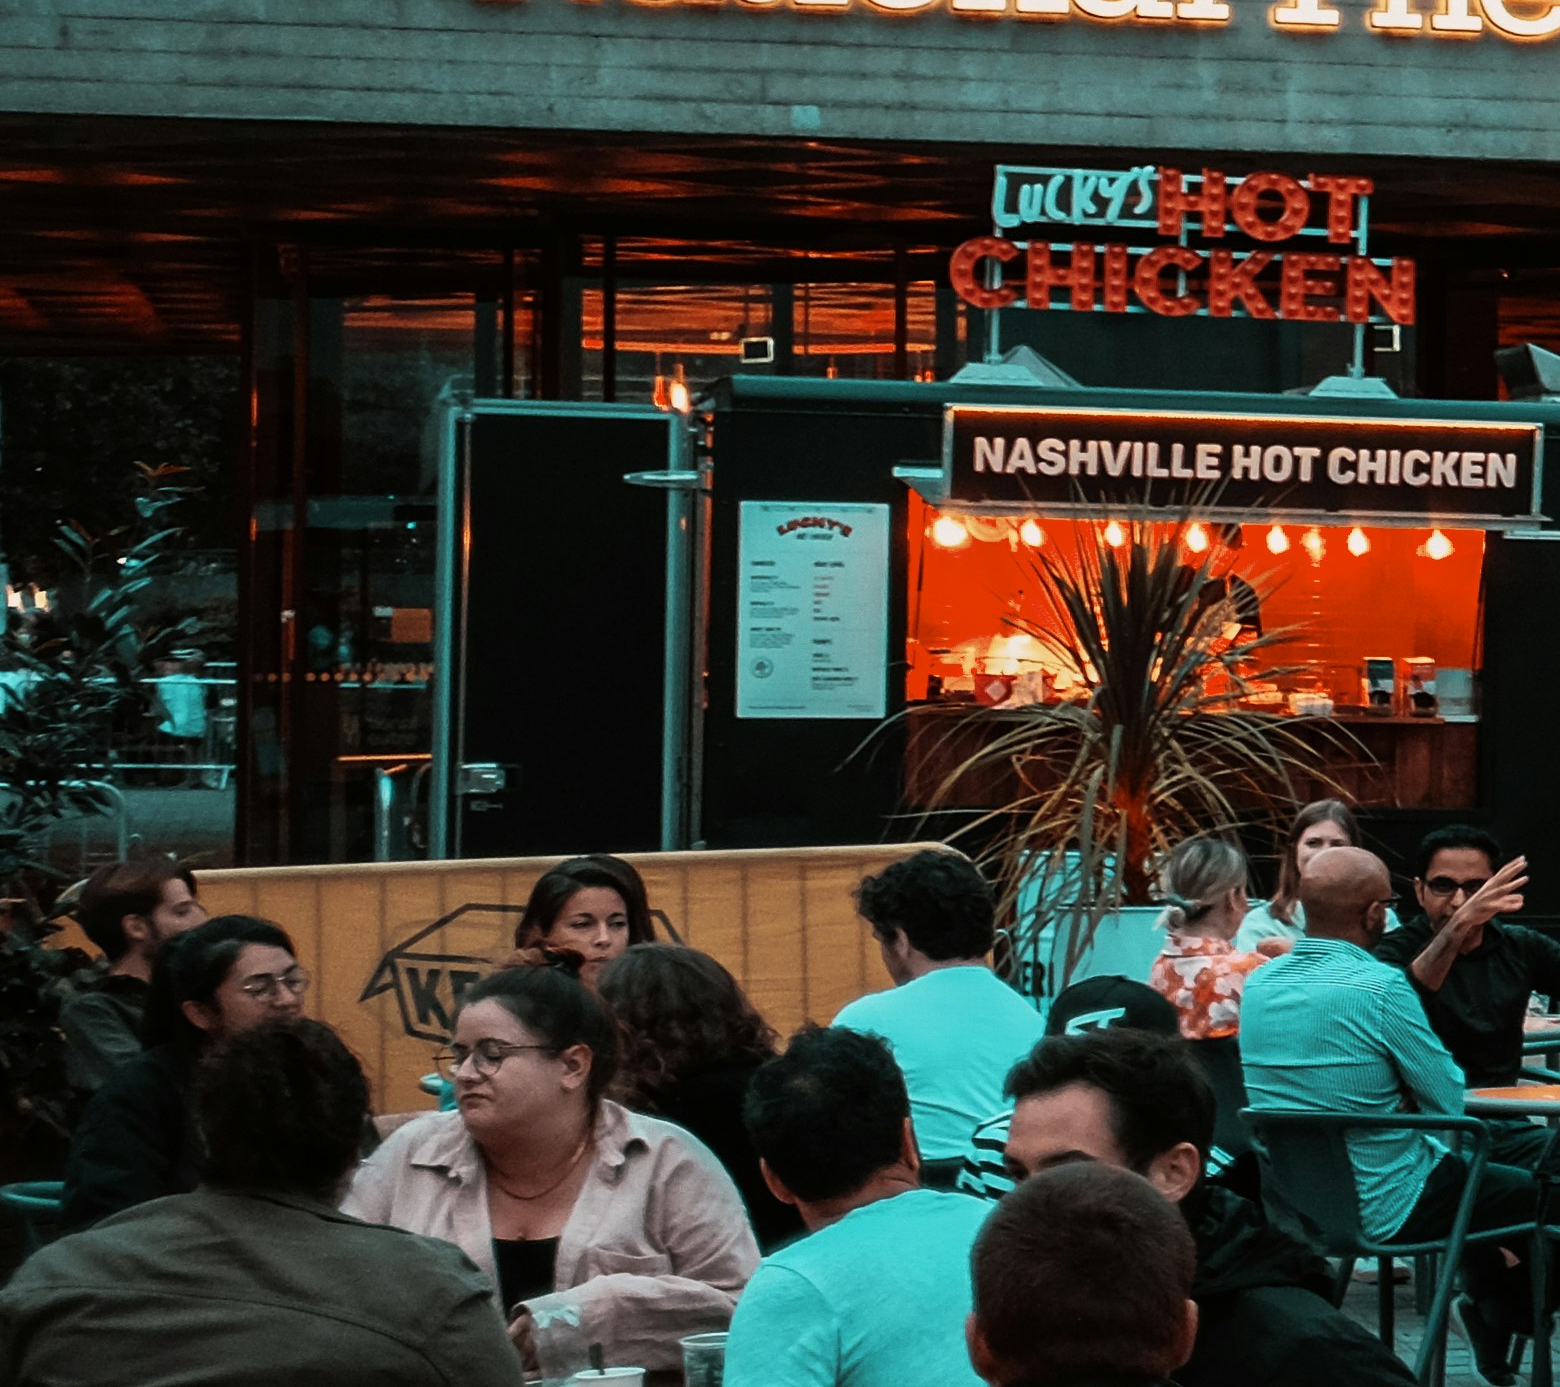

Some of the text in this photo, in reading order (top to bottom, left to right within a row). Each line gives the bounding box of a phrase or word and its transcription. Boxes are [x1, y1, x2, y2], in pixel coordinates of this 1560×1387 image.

[1157, 167, 1375, 245] HOT
[949, 235, 1416, 326] CHICKEN
[973, 436, 1518, 488] NASHVILLE HOT CHICKEN
